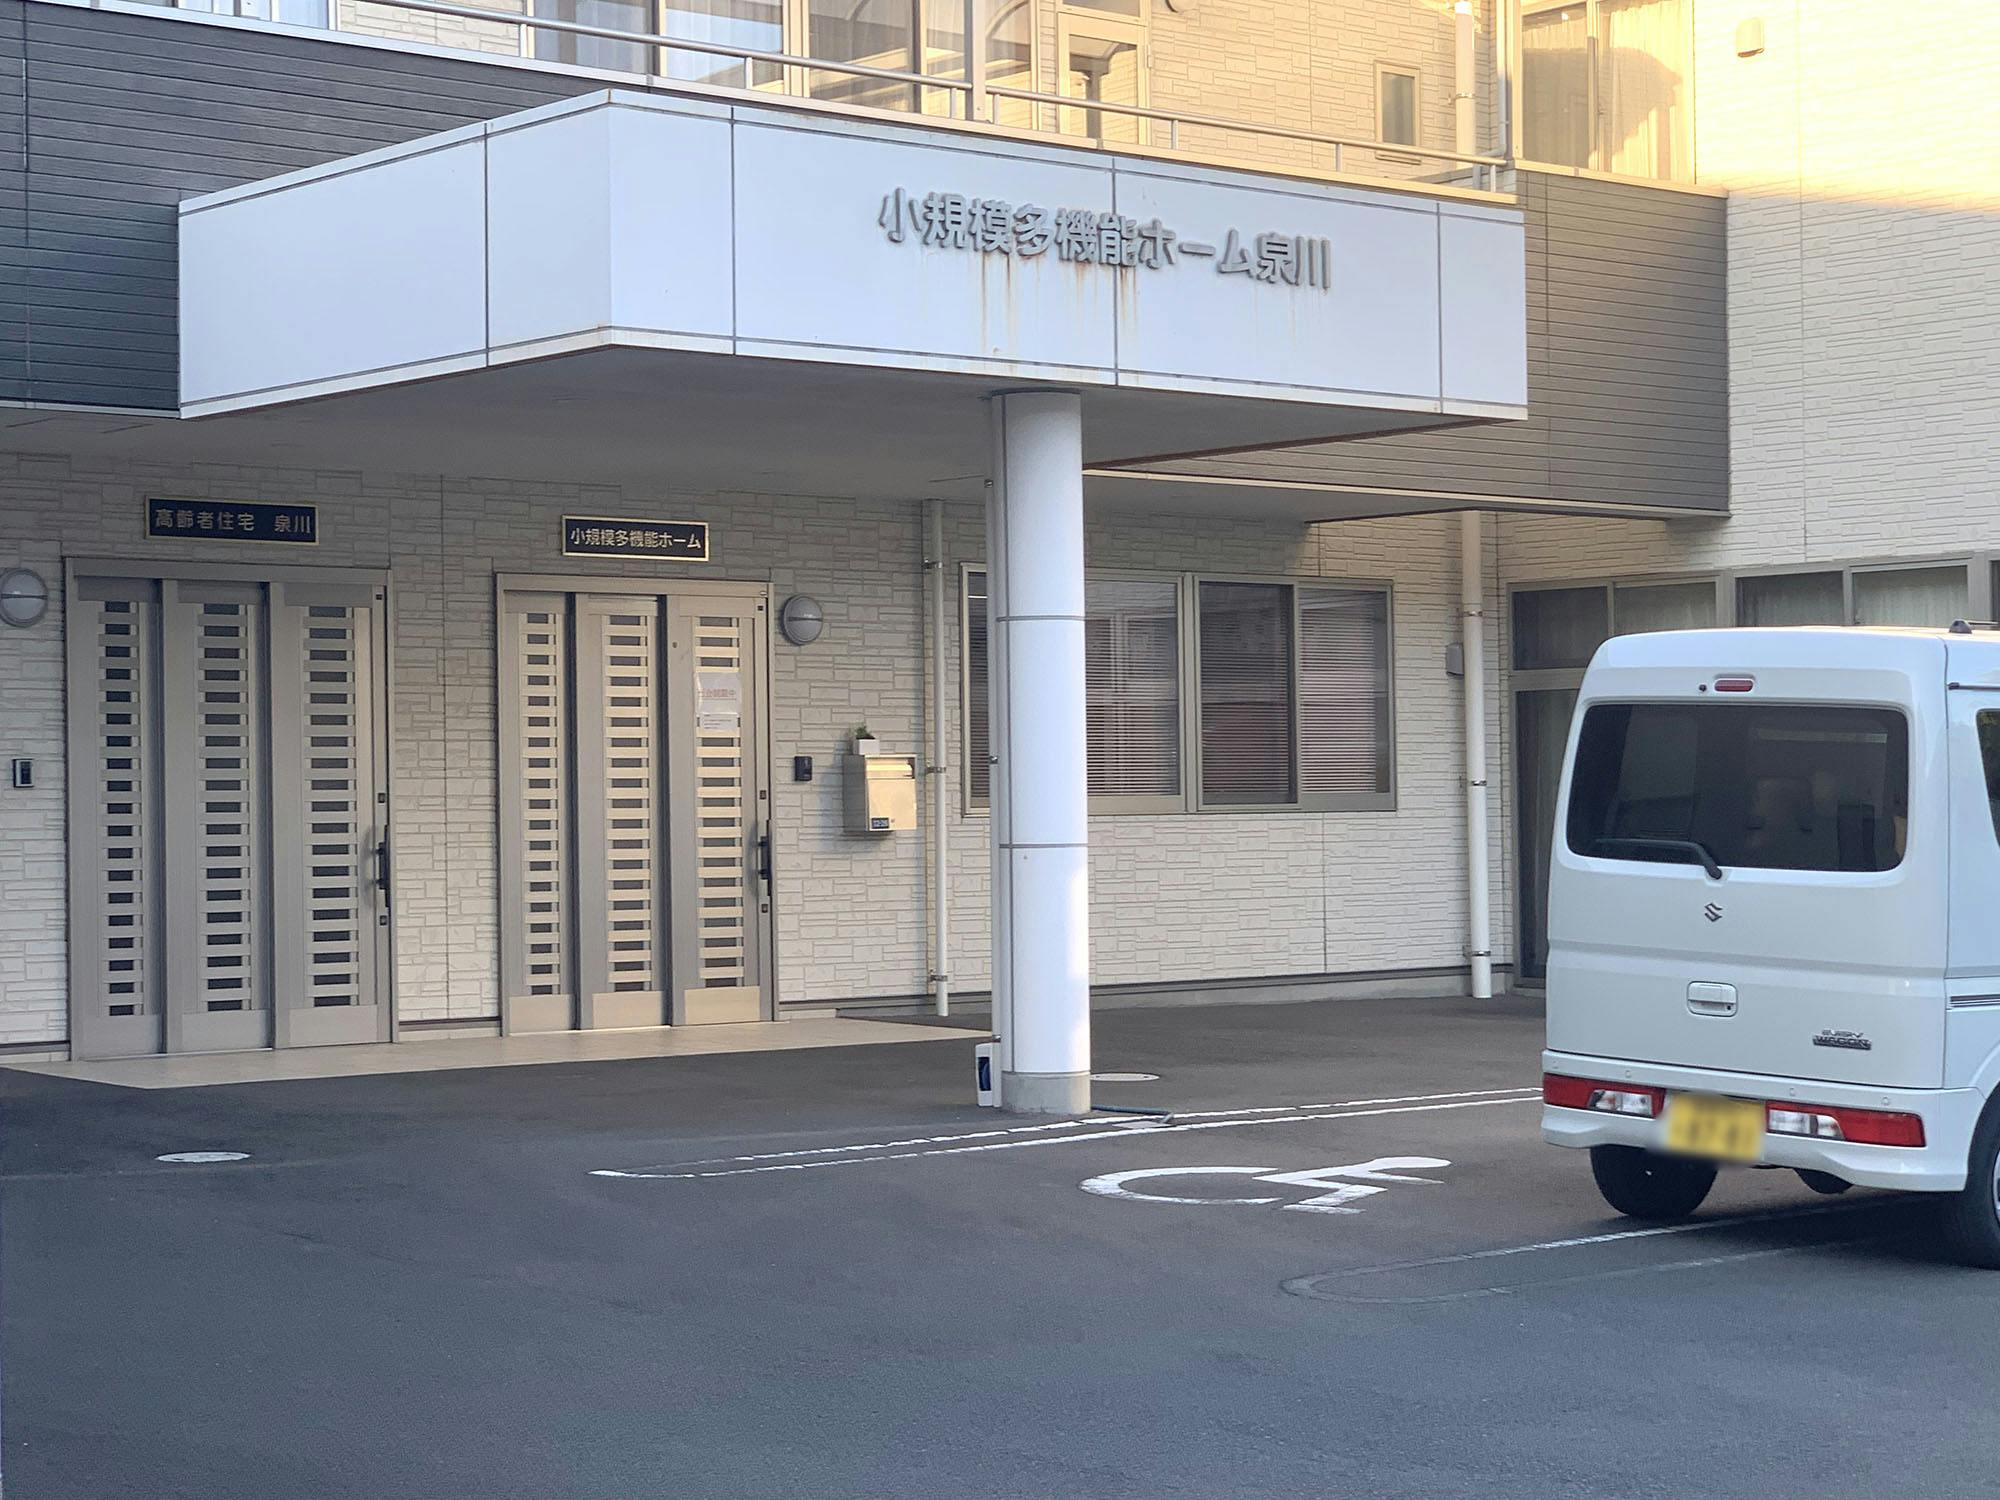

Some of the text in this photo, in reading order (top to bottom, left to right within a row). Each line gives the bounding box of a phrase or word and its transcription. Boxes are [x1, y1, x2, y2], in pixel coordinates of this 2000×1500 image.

[879, 187, 1331, 289] 小規模多機能ホーム泉川
[273, 514, 311, 534] 泉川
[571, 527, 702, 549] 小規模多機能ホーム
